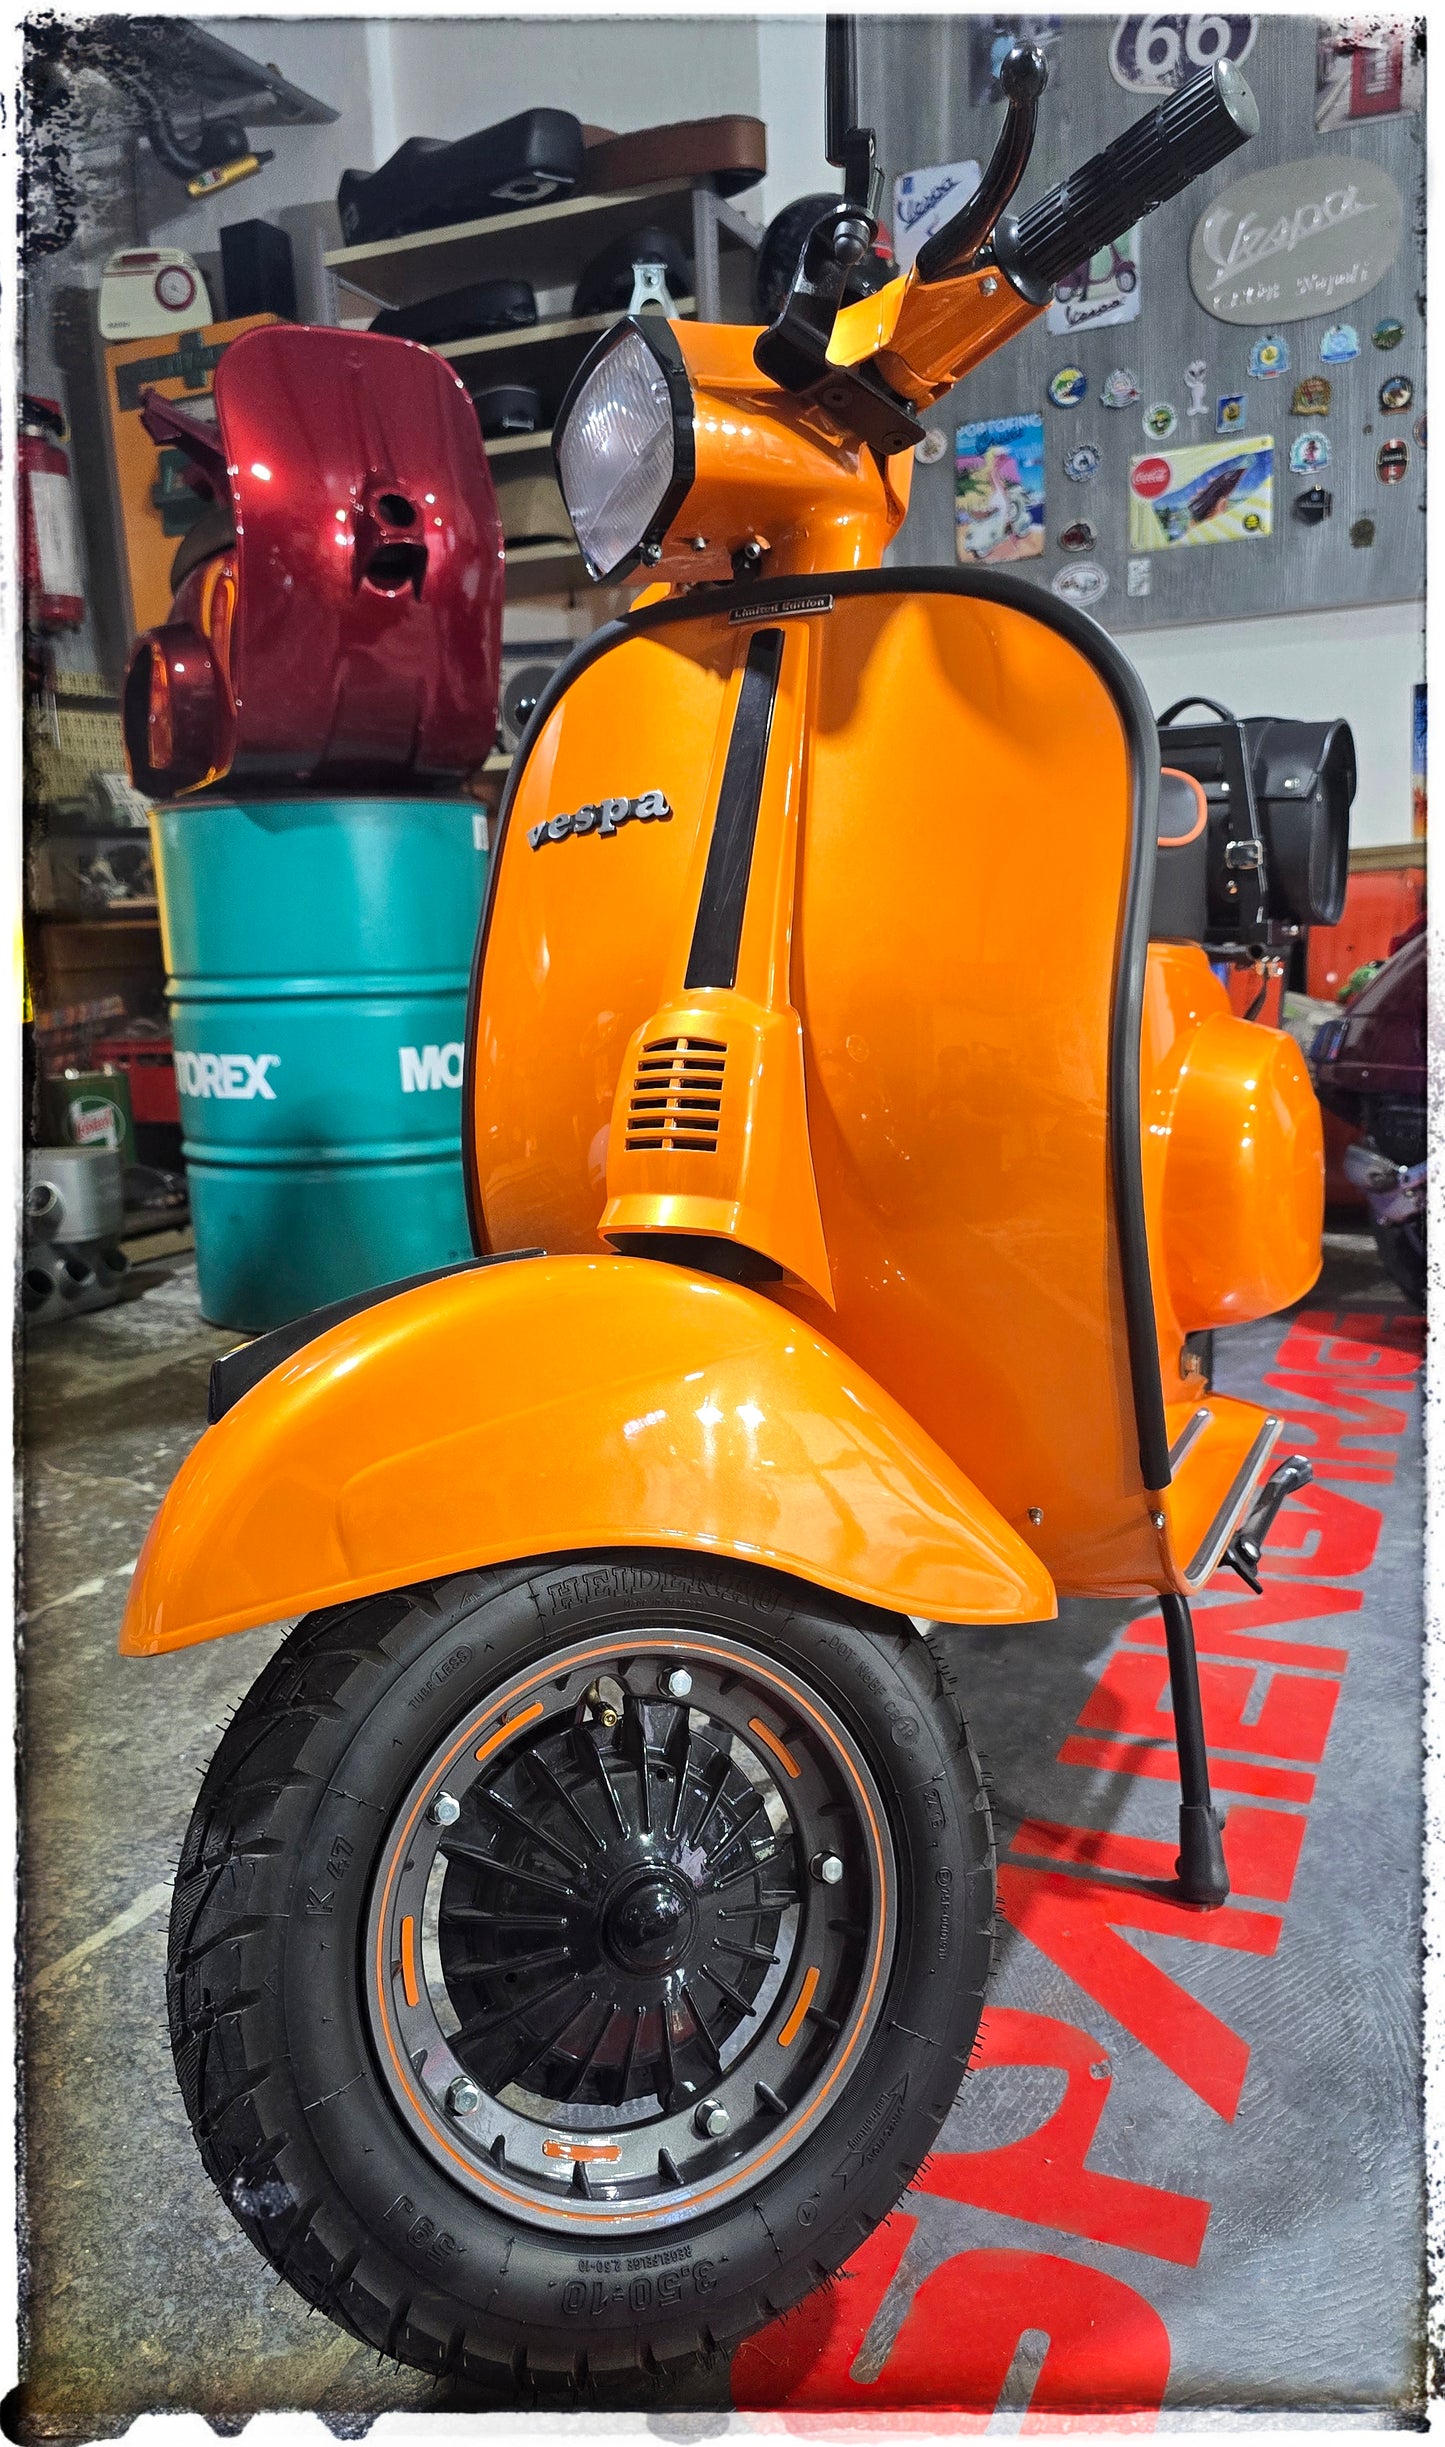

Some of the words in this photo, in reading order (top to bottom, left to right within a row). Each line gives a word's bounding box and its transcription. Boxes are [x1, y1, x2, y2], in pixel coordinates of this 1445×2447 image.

[1135, 14, 1232, 67] 66
[1203, 185, 1380, 291] Vespa
[734, 604, 779, 619] Limited
[781, 599, 825, 612] Edition
[526, 788, 673, 852] vespa
[399, 1042, 465, 1093] MO
[547, 1563, 783, 1616] HEIDENAU
[305, 1886, 335, 1915] K
[865, 2104, 906, 2164] DIRECTION
[626, 2244, 693, 2272] REGELFELGE
[561, 2258, 718, 2316] 3.50-10
